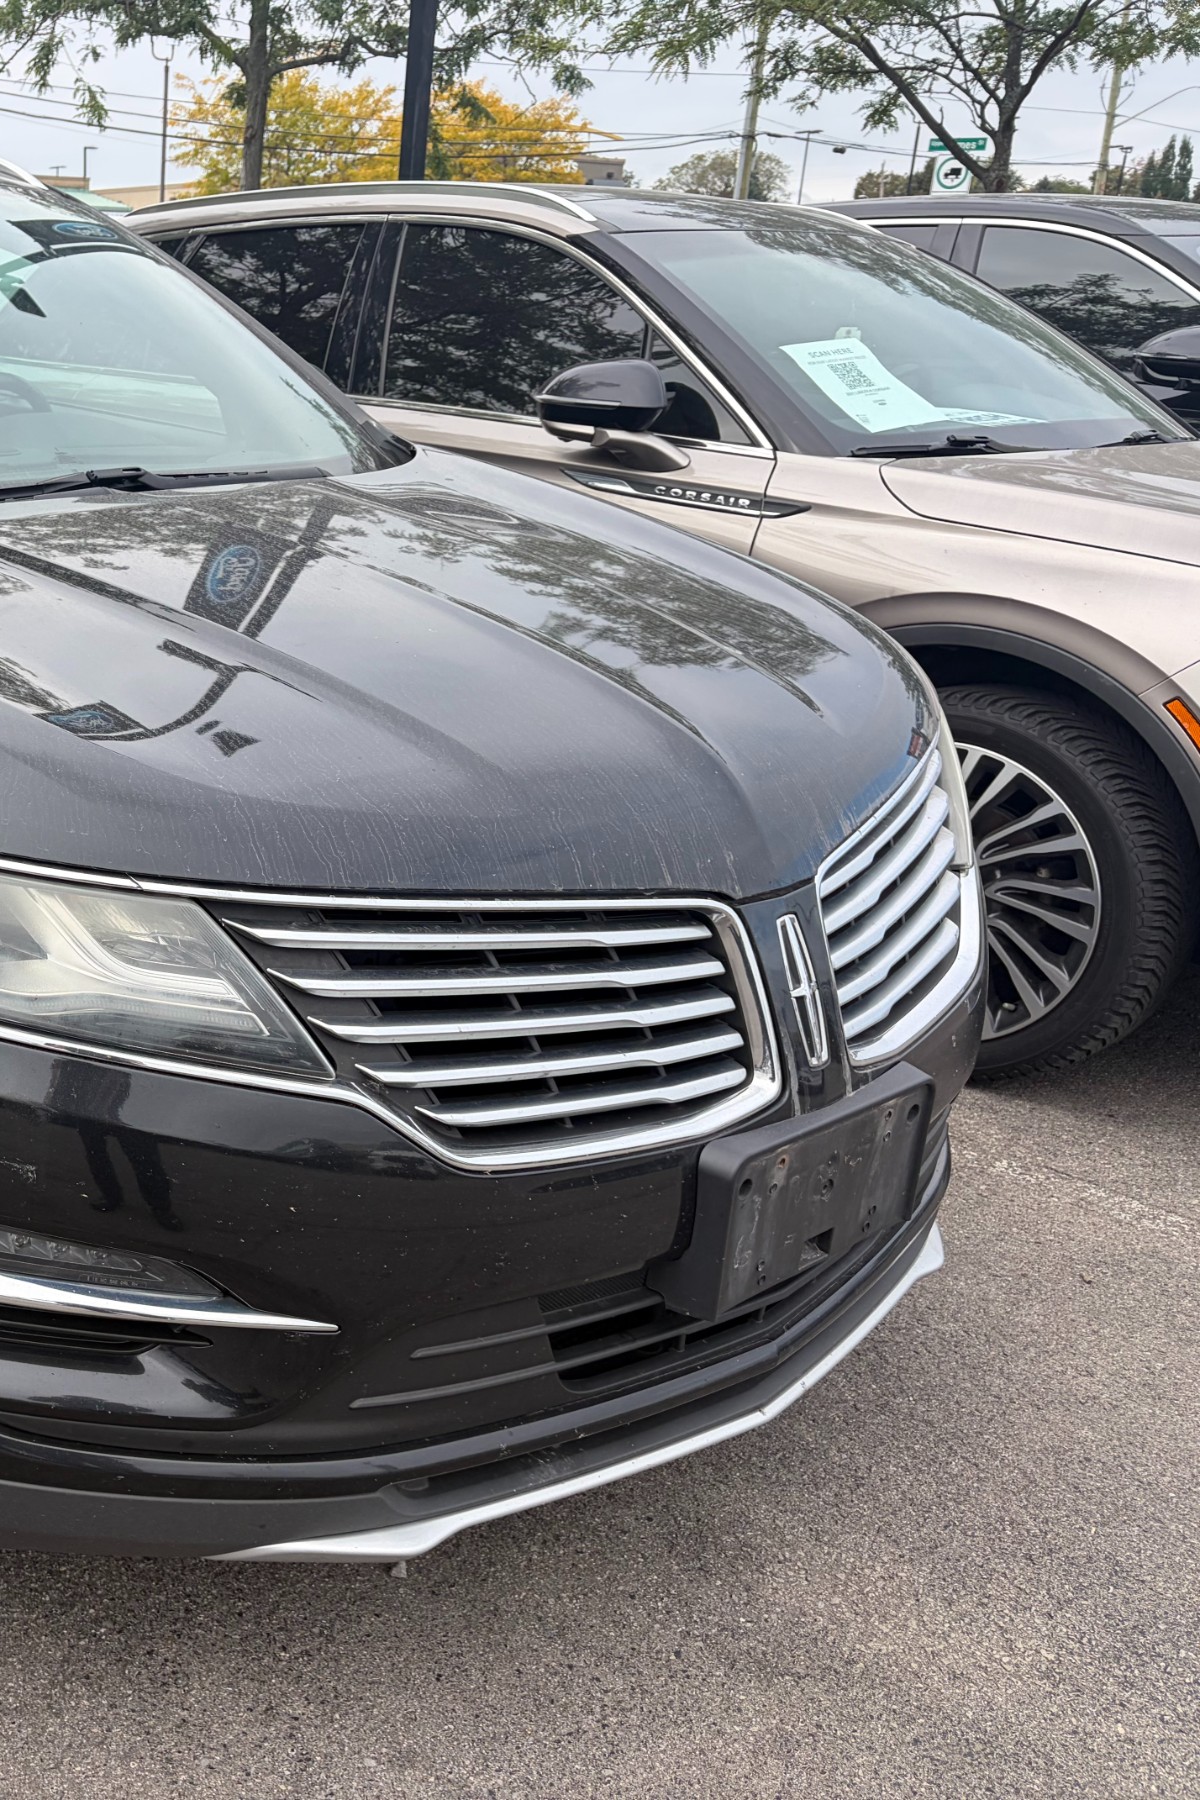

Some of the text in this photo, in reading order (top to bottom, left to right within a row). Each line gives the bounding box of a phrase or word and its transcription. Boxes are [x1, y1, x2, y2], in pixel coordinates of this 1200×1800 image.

[808, 347, 854, 359] SCAN HERE
[654, 485, 750, 508] CORSAIR
